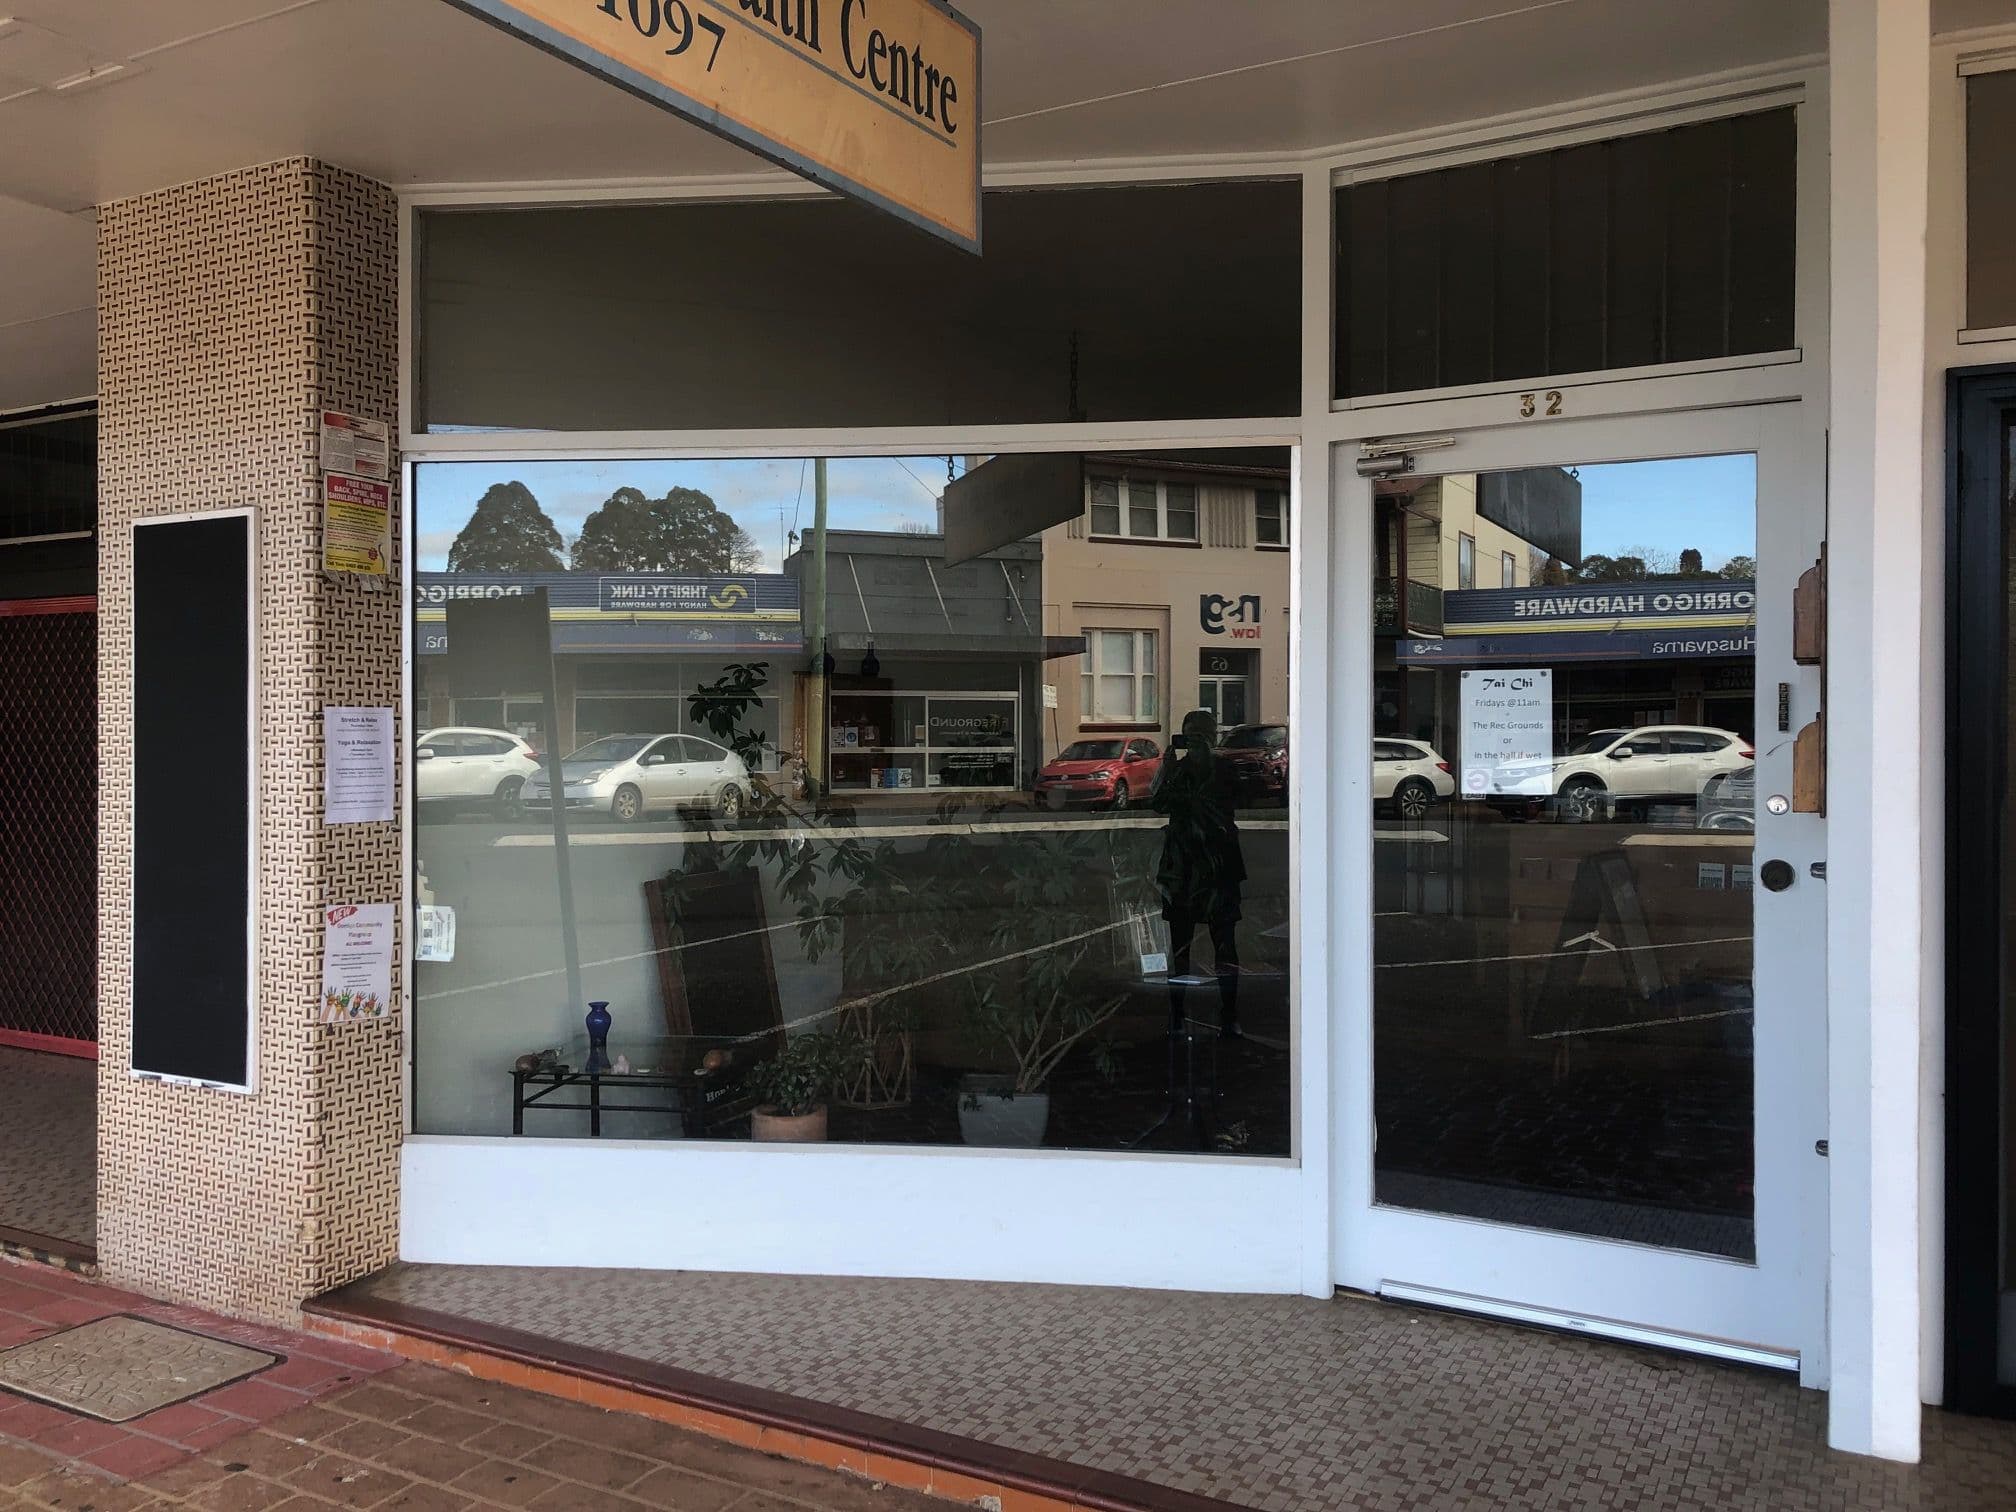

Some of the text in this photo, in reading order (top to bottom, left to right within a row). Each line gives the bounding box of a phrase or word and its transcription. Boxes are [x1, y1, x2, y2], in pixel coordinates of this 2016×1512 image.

[841, 0, 958, 134] Centre
[1519, 390, 1563, 417] 32
[1482, 677, 1533, 691] Tai Chi
[1475, 698, 1541, 708] Fridays @11am
[1473, 721, 1544, 730] The Rec Grounds
[1483, 751, 1498, 759] the
[1500, 751, 1516, 759] hall
[1517, 751, 1524, 759] if
[332, 905, 353, 924] NEW
